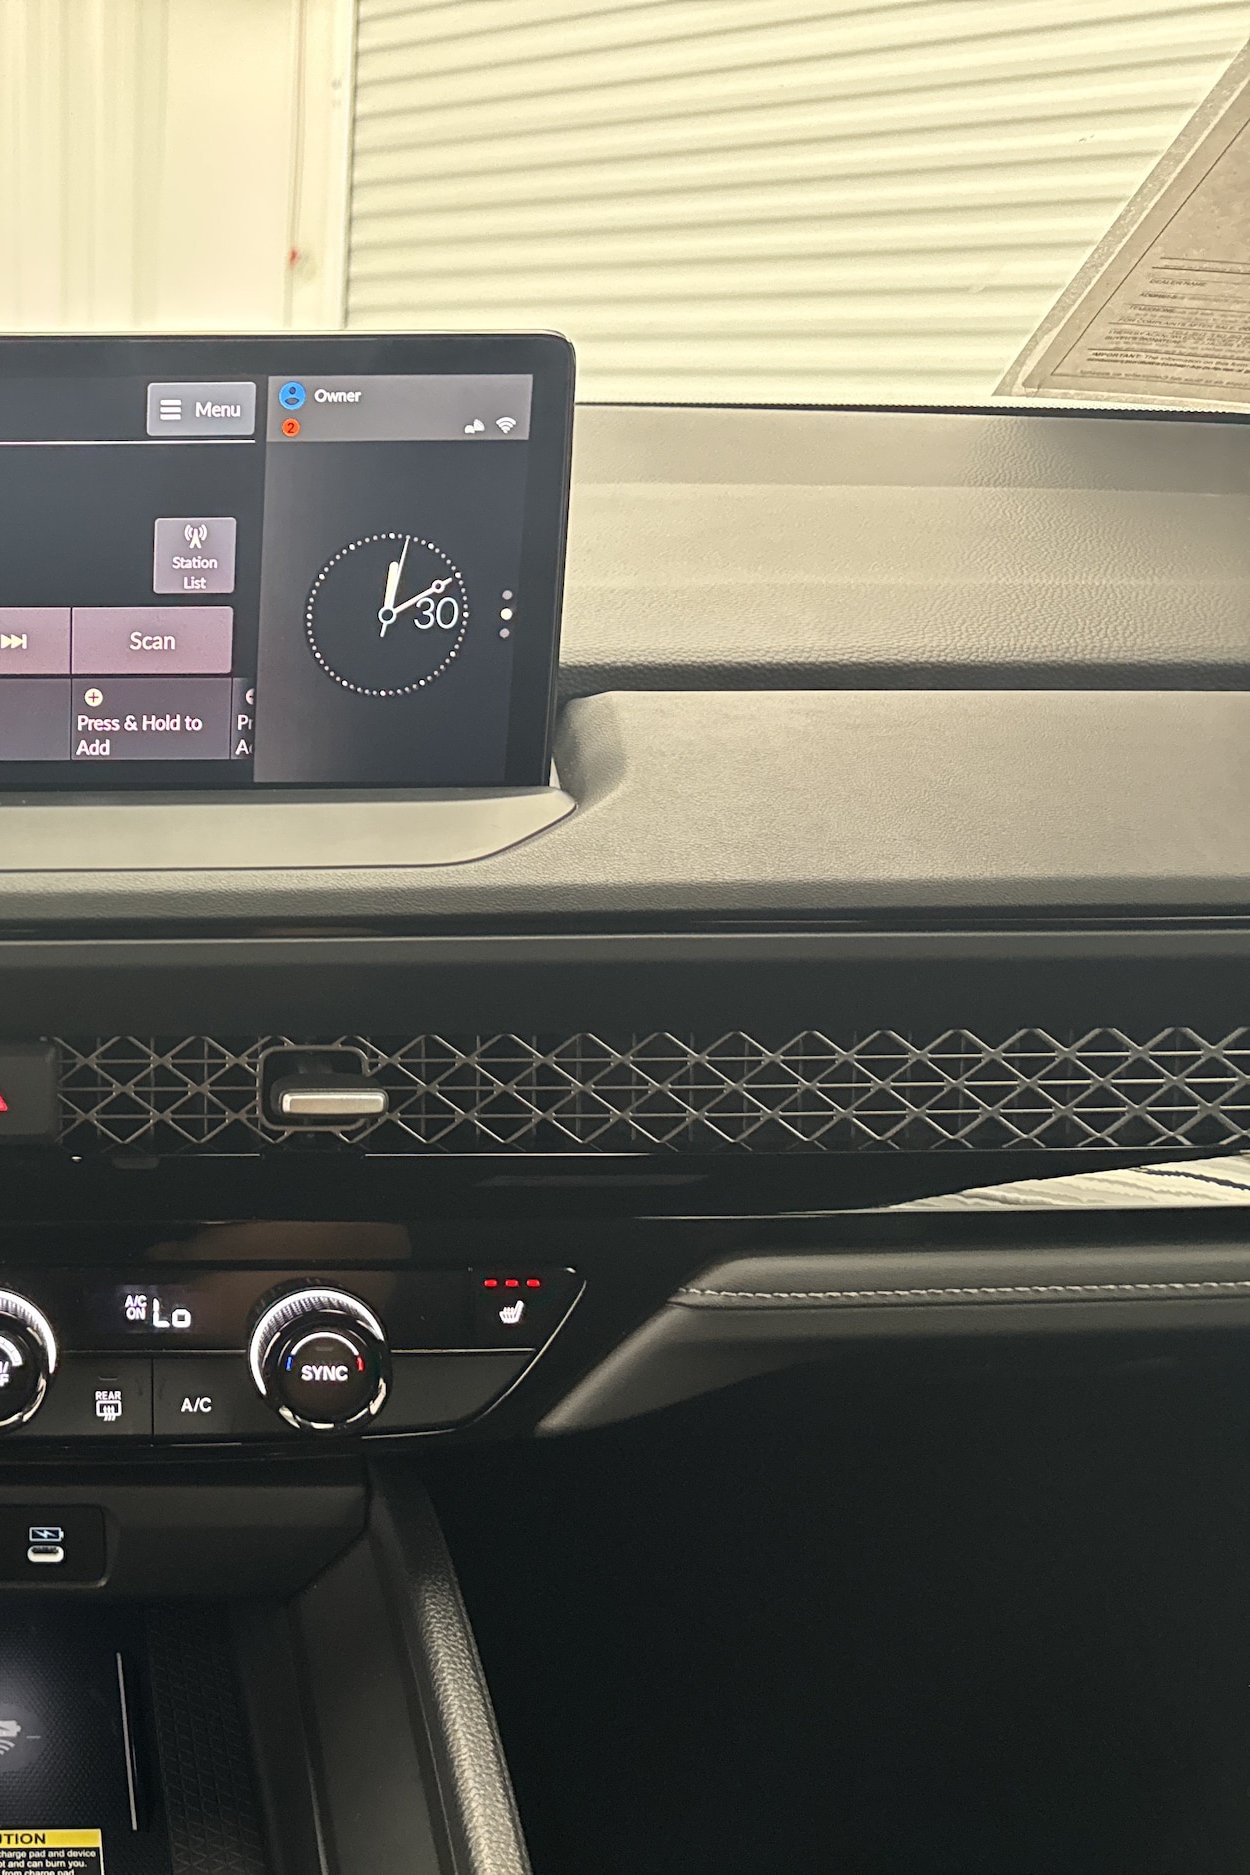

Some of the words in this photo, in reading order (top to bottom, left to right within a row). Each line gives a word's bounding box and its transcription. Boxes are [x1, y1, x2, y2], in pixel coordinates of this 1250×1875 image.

[314, 388, 362, 403] Owner
[195, 401, 241, 418] Menu
[286, 421, 296, 435] 2
[171, 555, 218, 570] Station
[182, 576, 207, 590] List
[413, 597, 460, 629] 30
[129, 631, 176, 650] Scan
[77, 714, 121, 732] Press
[123, 714, 139, 732] &
[142, 713, 181, 731] Hold
[184, 715, 203, 731] to
[75, 738, 111, 756] Add
[124, 1294, 148, 1308] A/C
[126, 1307, 147, 1321] ON
[301, 1364, 348, 1382] SYNC
[93, 1390, 123, 1402] REAR
[180, 1396, 212, 1413] A/C
[29, 1849, 46, 1860] pad
[47, 1849, 65, 1858] and
[66, 1848, 96, 1858] device
[7, 1859, 25, 1868] and
[26, 1860, 43, 1868] can
[45, 1858, 66, 1868] burn
[67, 1860, 88, 1870] you.
